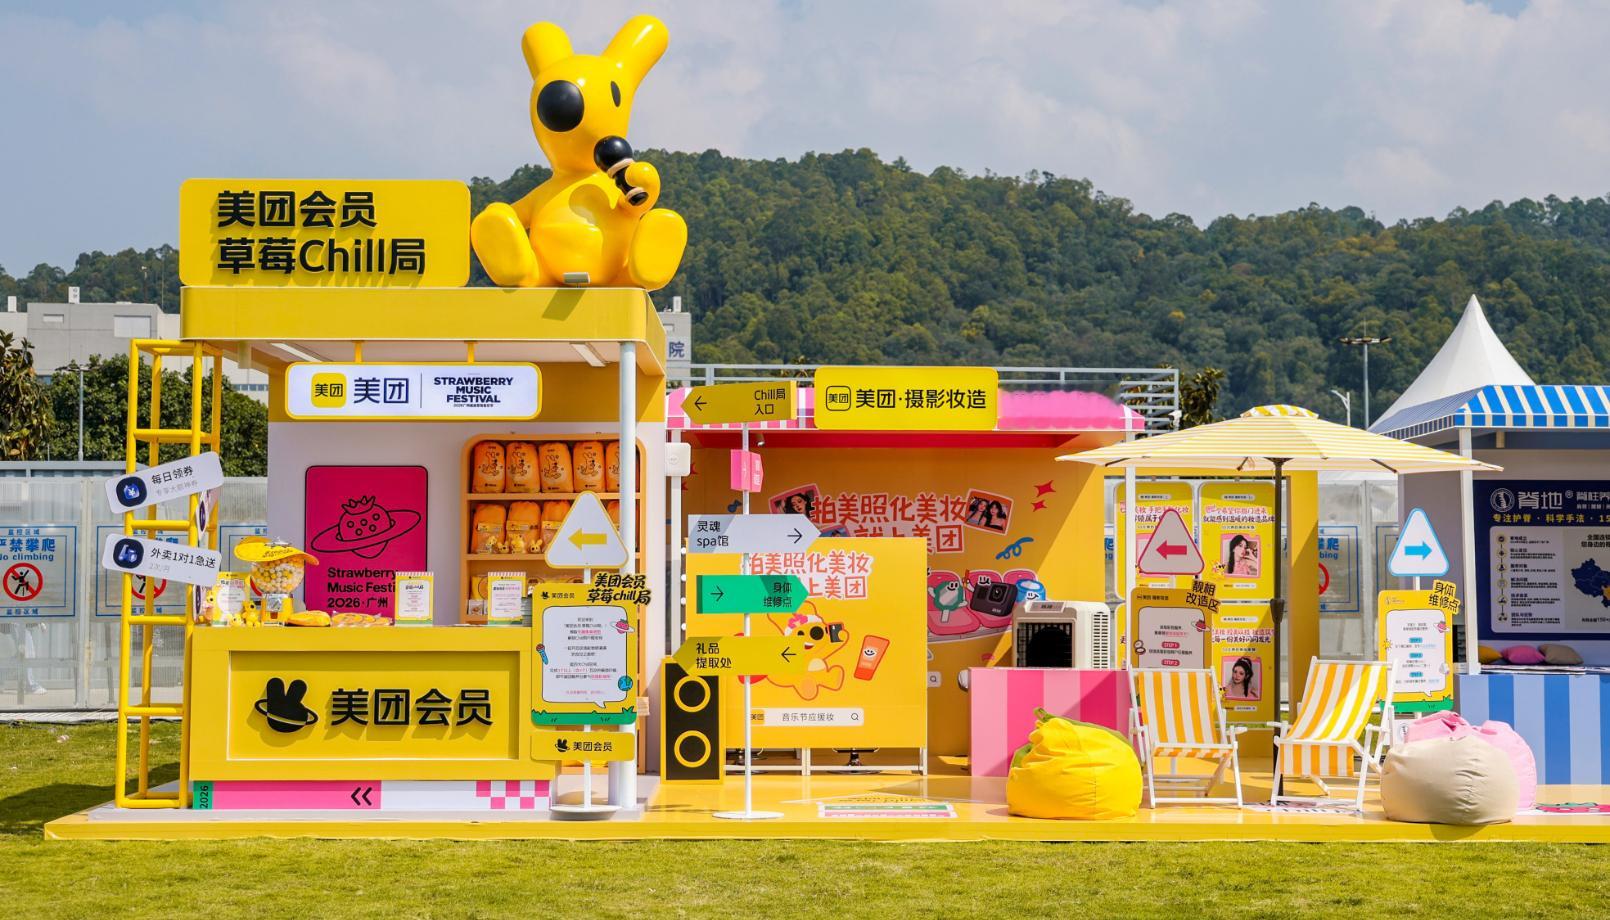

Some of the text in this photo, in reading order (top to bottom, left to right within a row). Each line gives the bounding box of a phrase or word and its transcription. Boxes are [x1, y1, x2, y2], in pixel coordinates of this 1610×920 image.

[217, 190, 378, 228] 美团会员
[217, 237, 426, 275] 草莓Chill局
[668, 341, 685, 358] 院
[433, 376, 514, 386] STRAWBERRY
[314, 383, 344, 398] 美团
[353, 377, 410, 404] 美团
[455, 385, 492, 395] MUSIC
[754, 388, 786, 401] Chill局
[446, 394, 501, 404] FESTIVAL
[828, 393, 849, 404] 美团
[855, 389, 987, 409] 美团·摄影妆造
[754, 403, 775, 416] 入口
[151, 465, 193, 485] 每日领券
[1518, 491, 1562, 510] 脊地
[811, 492, 968, 526] 拍美照化美妆
[697, 521, 721, 533] 灵魂
[697, 535, 729, 548] spa馆
[12, 553, 54, 562] climbing
[151, 547, 216, 569] 外卖1对1急送
[327, 567, 396, 580] Strawberry
[327, 582, 363, 593] Music
[594, 573, 647, 589] 美团会员
[773, 582, 792, 594] 身体
[1192, 580, 1216, 597] 靓相
[1435, 581, 1456, 597] 身体
[551, 592, 575, 600] 美团会员
[586, 588, 652, 606] 草莓chill局
[763, 596, 792, 609] 维修点
[1186, 591, 1221, 614] 改造区
[327, 597, 388, 609] 2026·广州
[1428, 593, 1459, 613] 维修点
[695, 642, 720, 655] 礼品
[695, 657, 732, 670] 提取处
[331, 688, 493, 727] 美团会员
[782, 712, 835, 722] 音乐节应援妆
[572, 741, 613, 752] 美团会员
[199, 784, 210, 809] 2026
